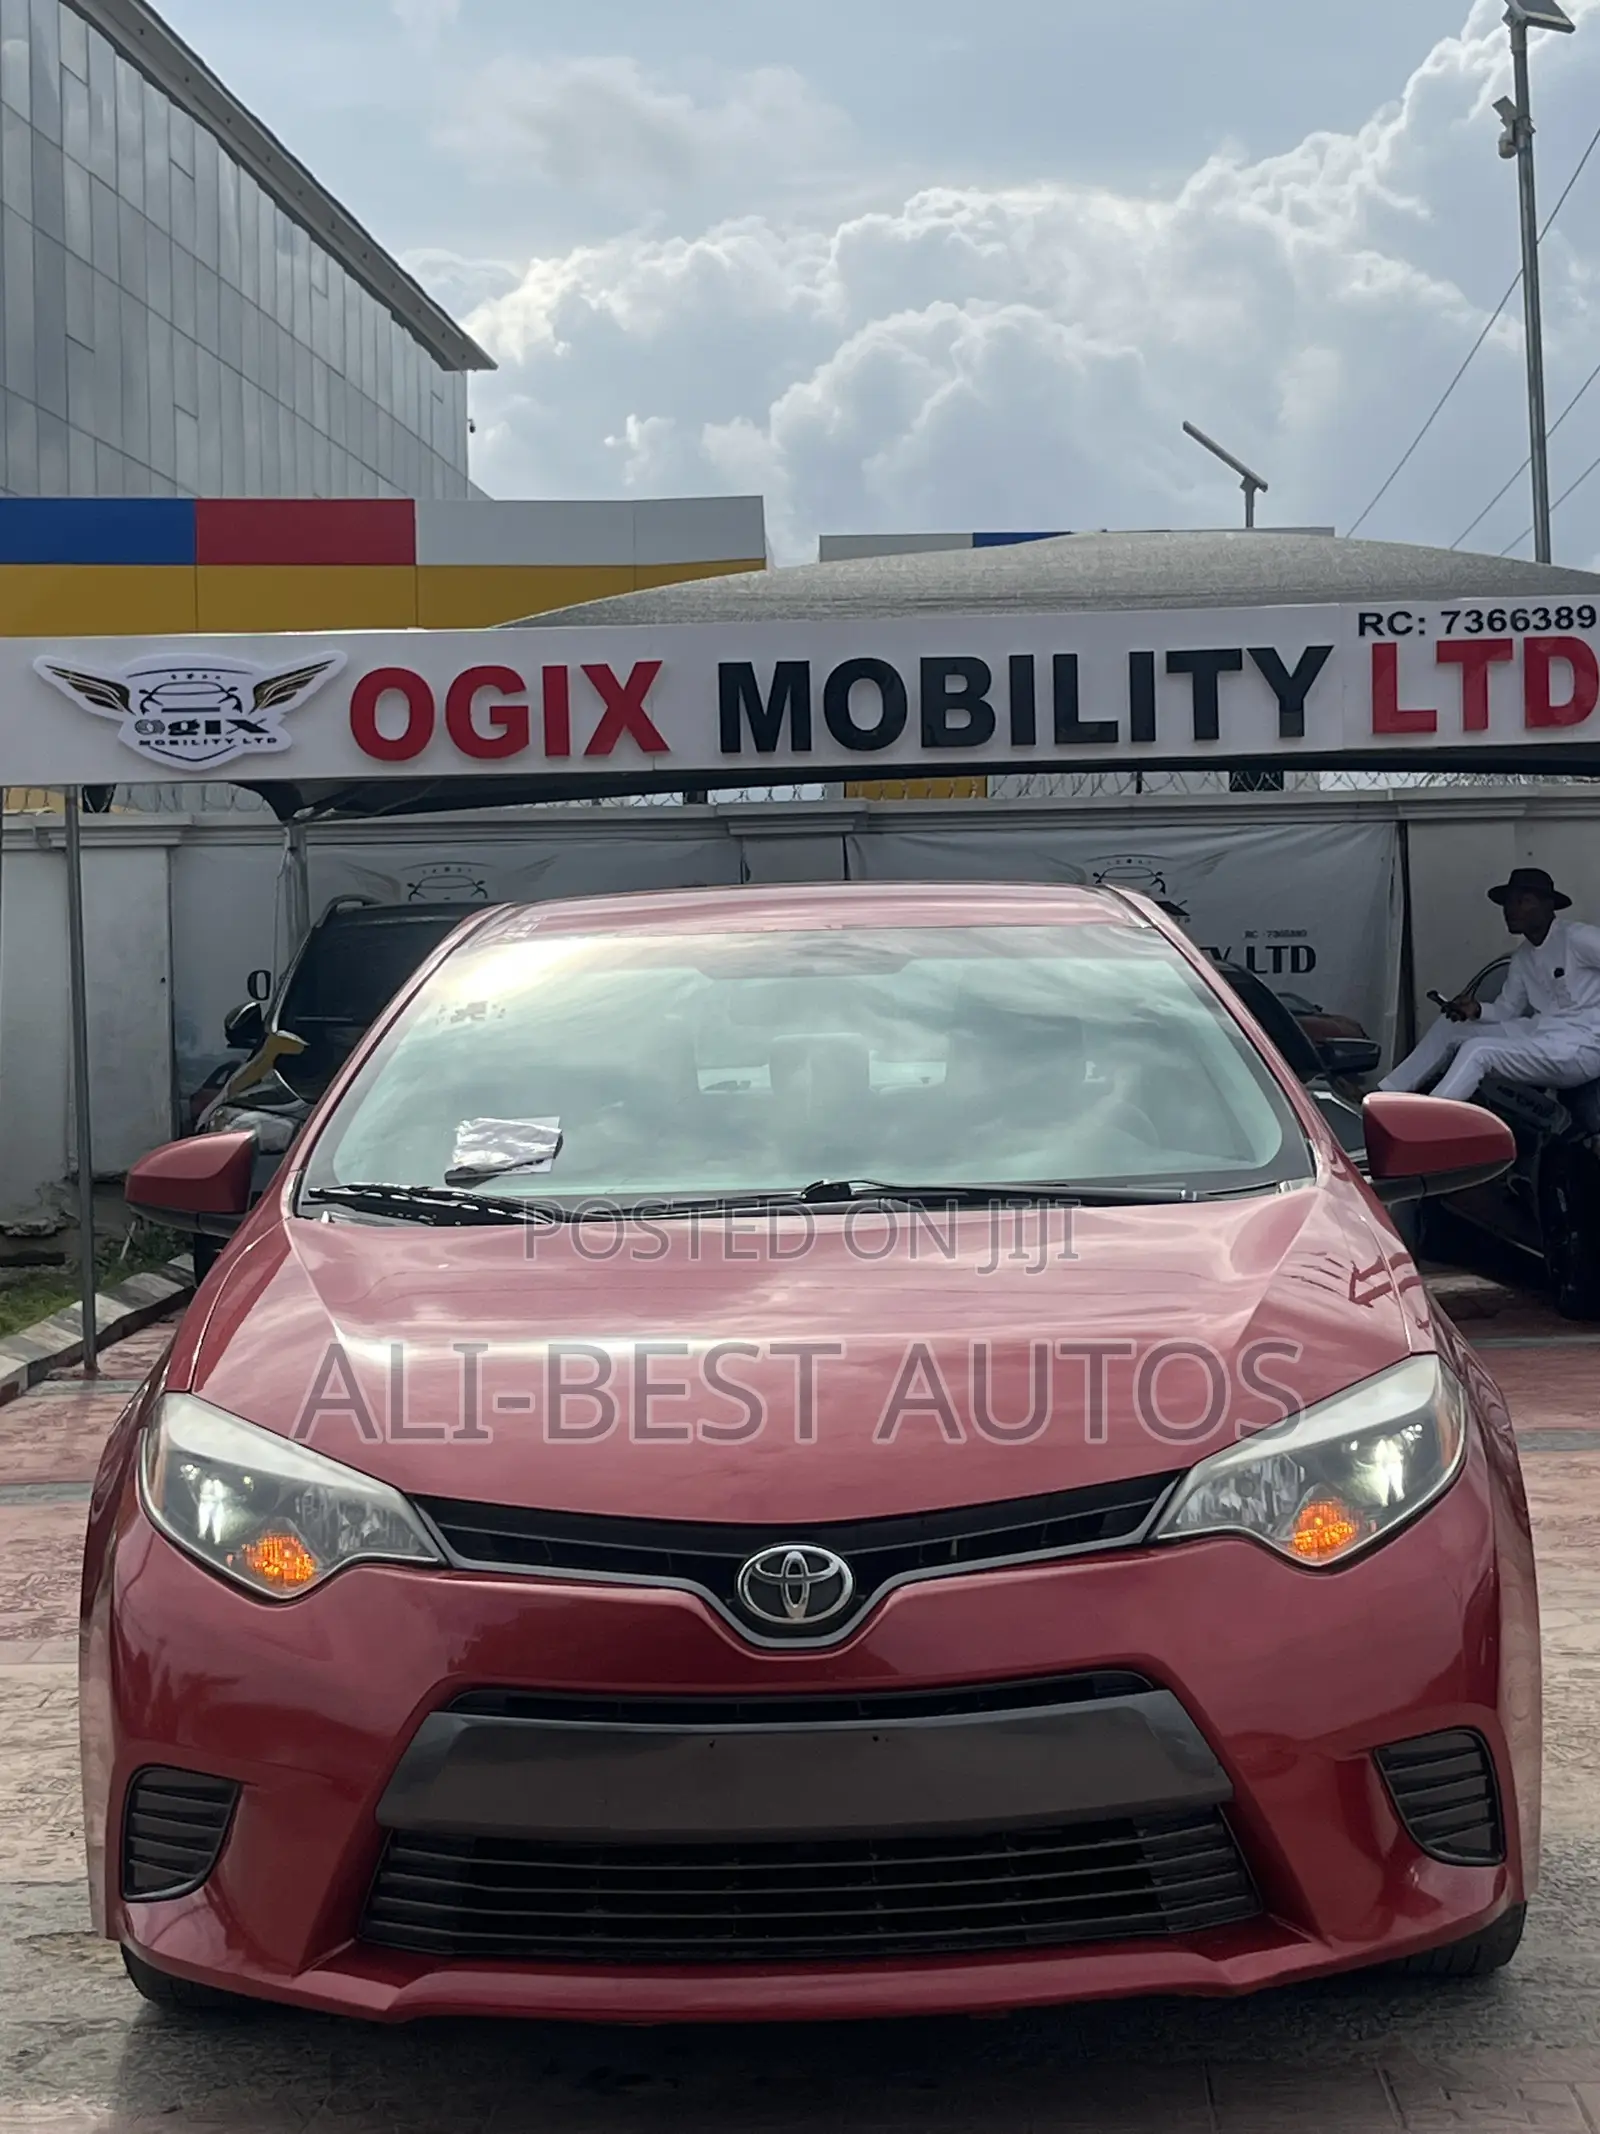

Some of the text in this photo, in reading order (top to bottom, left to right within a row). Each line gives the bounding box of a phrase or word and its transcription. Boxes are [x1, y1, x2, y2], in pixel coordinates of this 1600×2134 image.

[1358, 604, 1597, 637] RC: 7366389
[349, 635, 1599, 763] OGIX MOBILITY LTD
[138, 737, 278, 746] MOBILITY LTD
[1246, 945, 1317, 974] LTD
